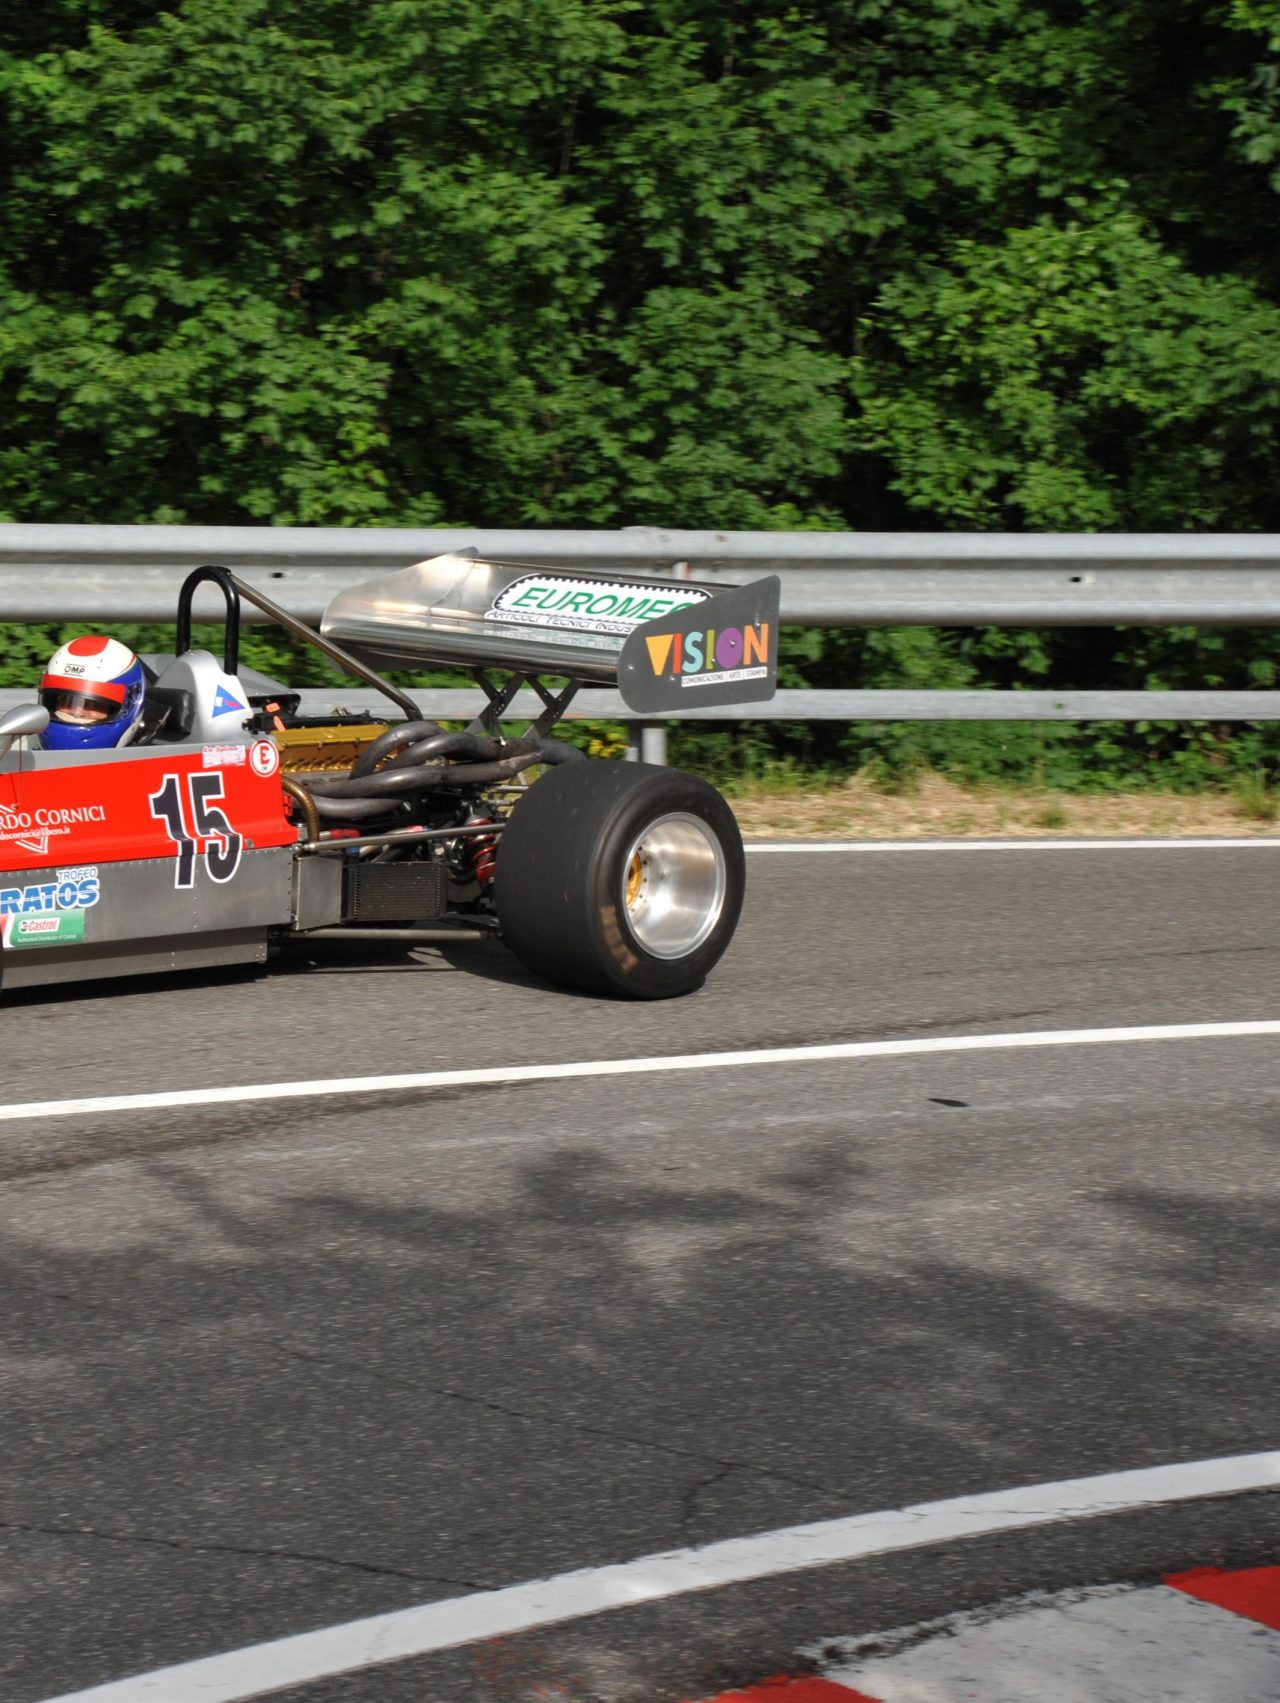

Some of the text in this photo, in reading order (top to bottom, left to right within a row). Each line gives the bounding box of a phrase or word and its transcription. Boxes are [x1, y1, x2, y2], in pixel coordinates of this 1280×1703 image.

[595, 622, 633, 633] INDUS
[645, 623, 769, 676] VISION
[64, 666, 85, 674] OMP
[35, 806, 106, 827] CORNICI
[148, 771, 243, 889] 15
[58, 868, 97, 881] TROFEO
[28, 919, 58, 932] Castrol
